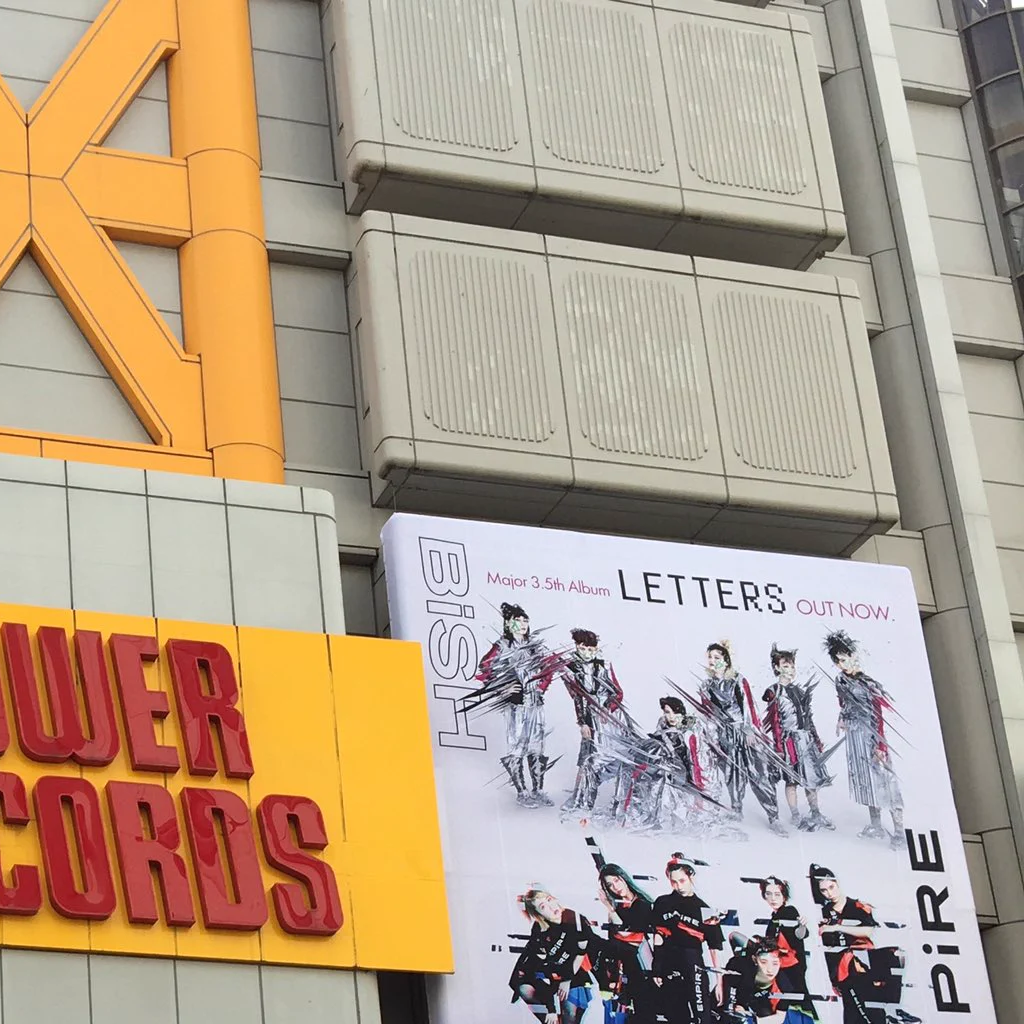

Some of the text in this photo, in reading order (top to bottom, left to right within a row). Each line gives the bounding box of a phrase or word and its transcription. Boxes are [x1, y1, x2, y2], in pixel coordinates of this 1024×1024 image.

[487, 569, 896, 622] Major 3.5th Album LETTERS OUT NOW.
